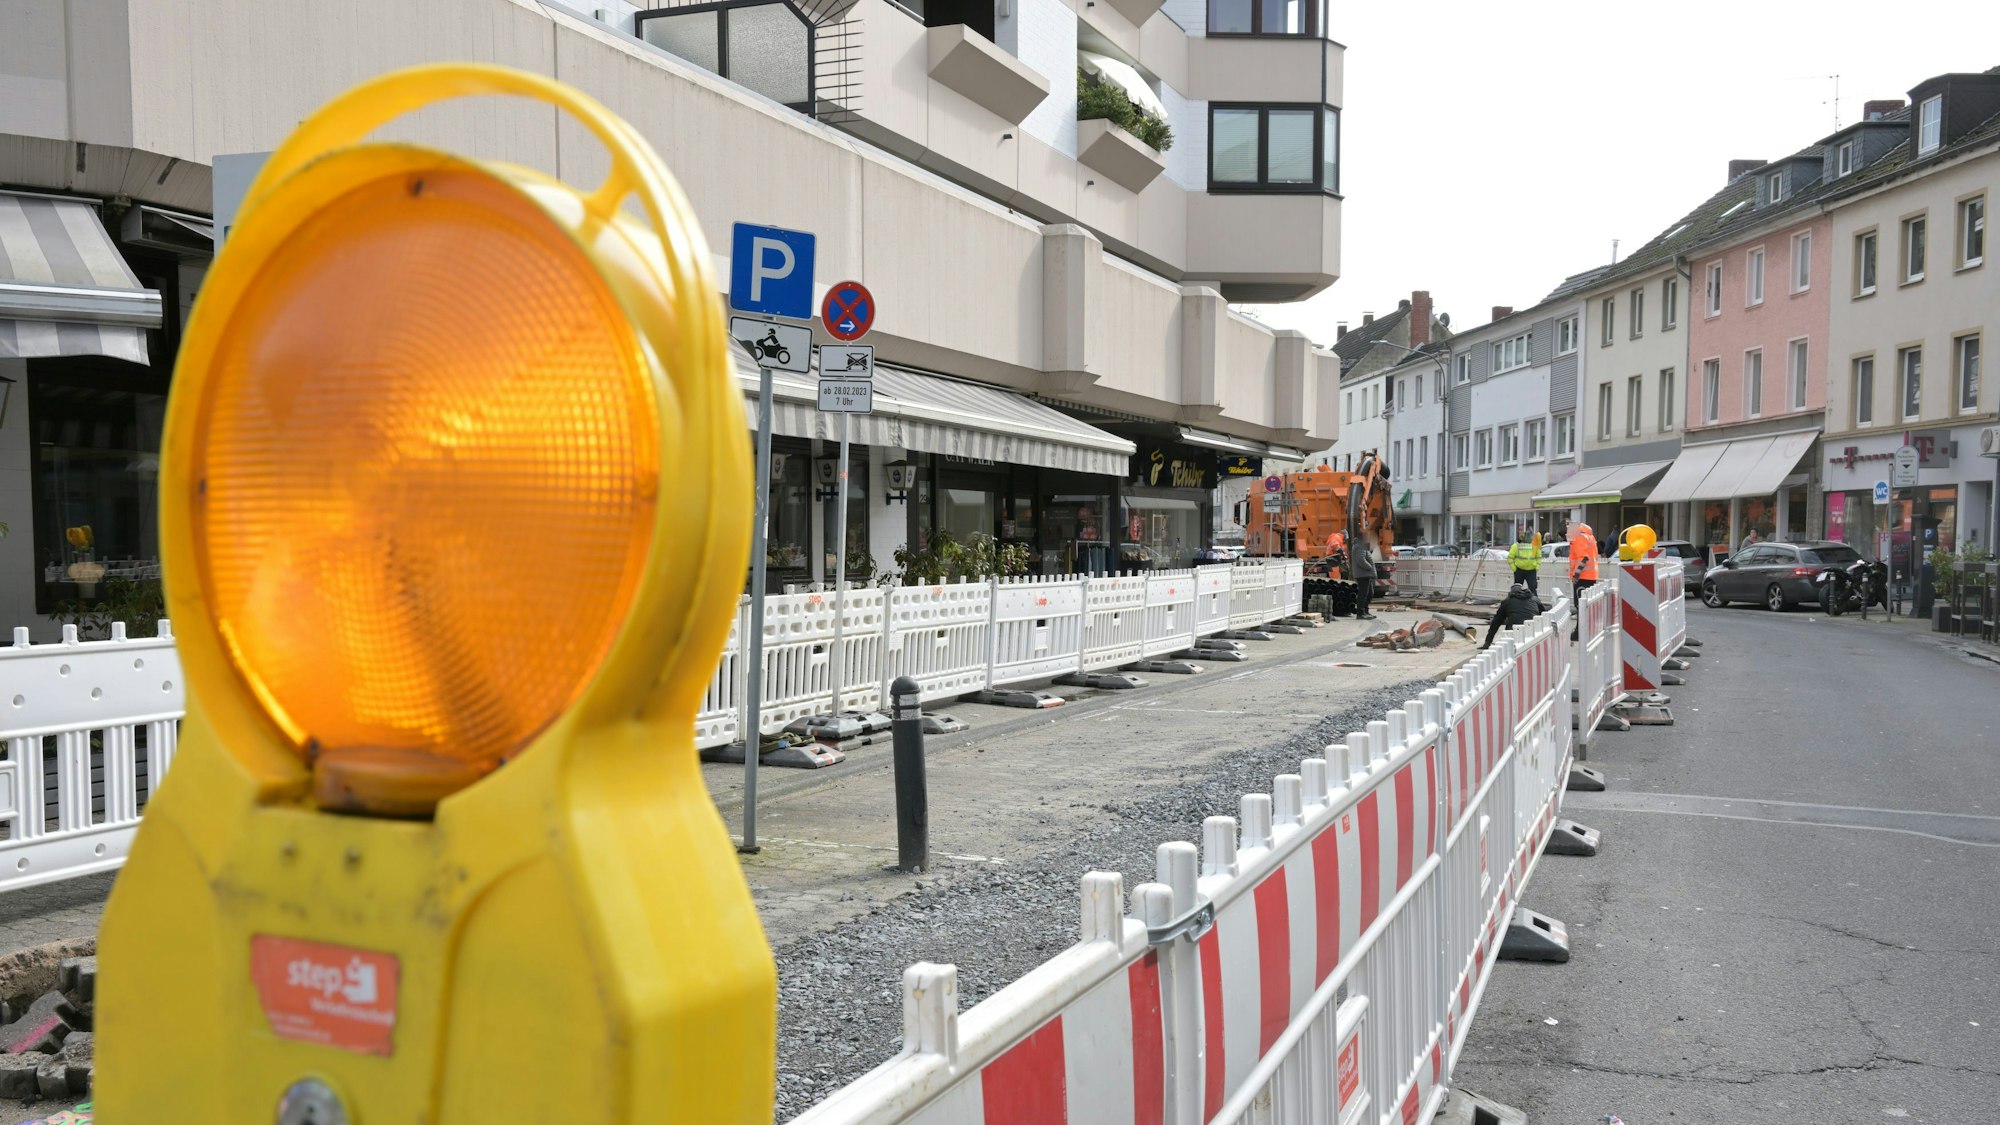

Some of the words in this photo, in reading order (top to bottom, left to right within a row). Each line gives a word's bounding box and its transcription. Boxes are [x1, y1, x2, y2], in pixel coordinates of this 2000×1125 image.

[750, 236, 796, 302] P
[823, 387, 832, 395] ab
[834, 386, 867, 396] 28.02.2023
[836, 397, 840, 406] 7
[842, 397, 854, 406] Uhr
[1171, 459, 1206, 488] Tchibo
[1227, 466, 1254, 475] Tchibo
[1875, 488, 1888, 497] WC
[1925, 528, 1932, 539] P
[287, 957, 343, 998] step
